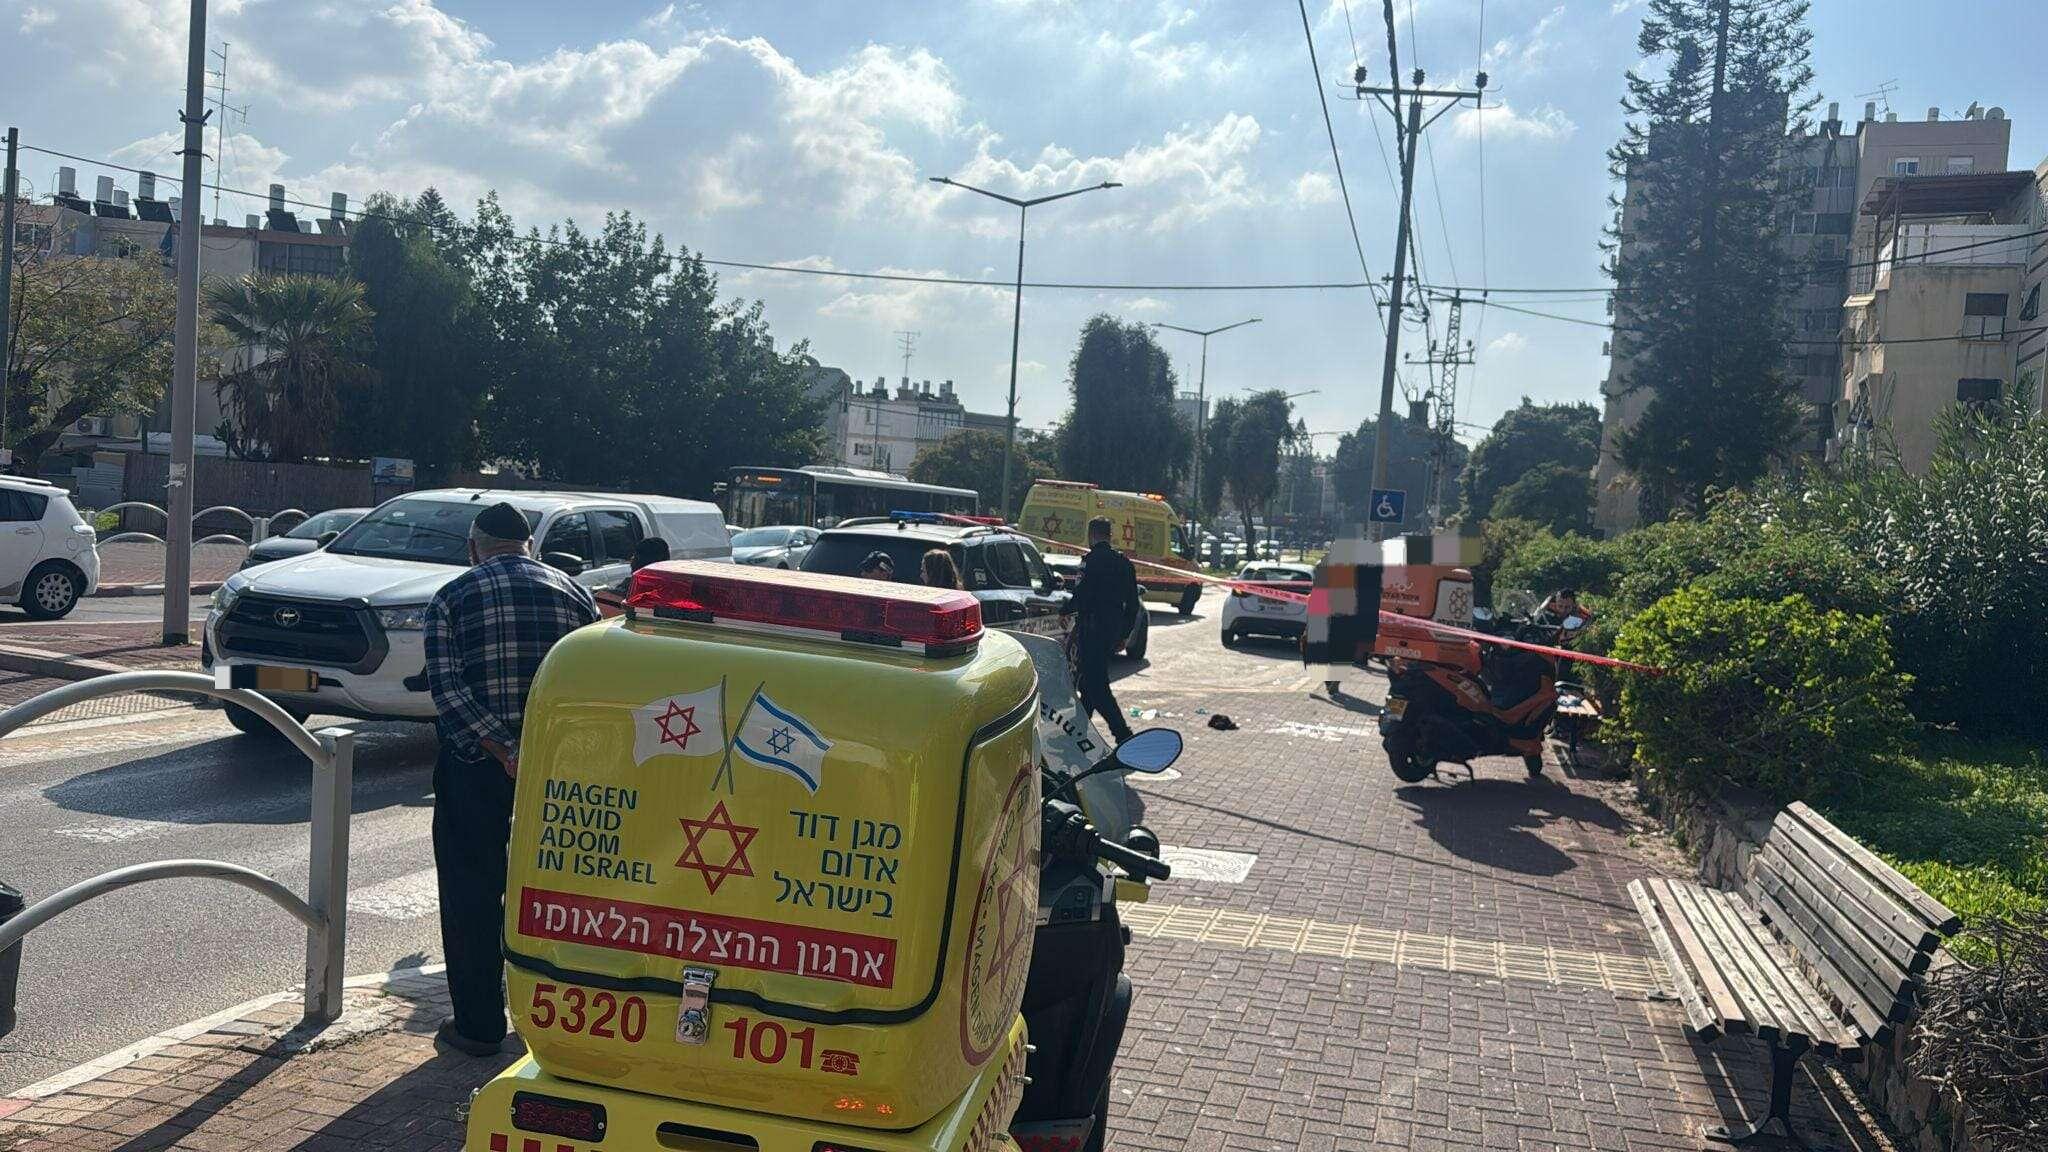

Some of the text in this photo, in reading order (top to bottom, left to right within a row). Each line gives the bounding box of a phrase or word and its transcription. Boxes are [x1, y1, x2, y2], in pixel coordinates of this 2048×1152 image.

[544, 778, 638, 810] MAGEN
[542, 802, 622, 831] DAVID
[789, 810, 902, 850] מגן דוד
[539, 825, 620, 856] ADOM
[537, 848, 658, 886] IN ISRAEL
[821, 849, 899, 885] אדום
[773, 870, 893, 919] בישראל
[532, 901, 886, 982] ארגון ההצלה הלאומי
[530, 982, 648, 1043] 5320
[724, 1016, 816, 1069] 101
